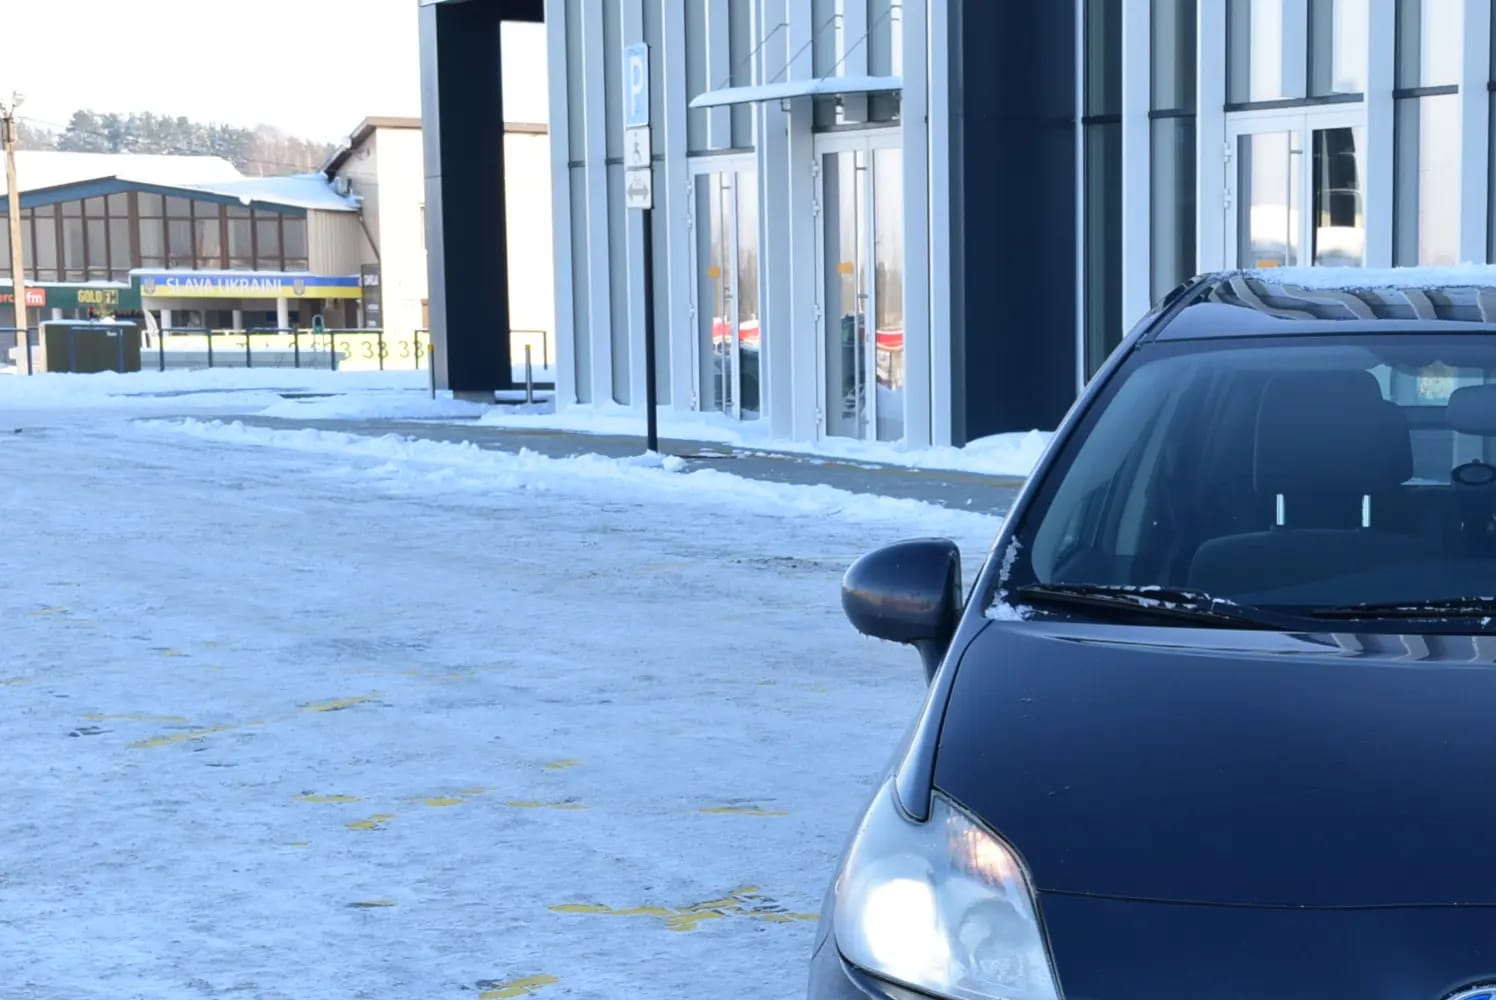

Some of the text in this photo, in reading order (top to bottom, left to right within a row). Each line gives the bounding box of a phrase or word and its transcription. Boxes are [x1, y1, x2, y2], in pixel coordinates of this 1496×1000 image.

[630, 55, 643, 117] P
[166, 278, 282, 293] SLAVA UKRAINI
